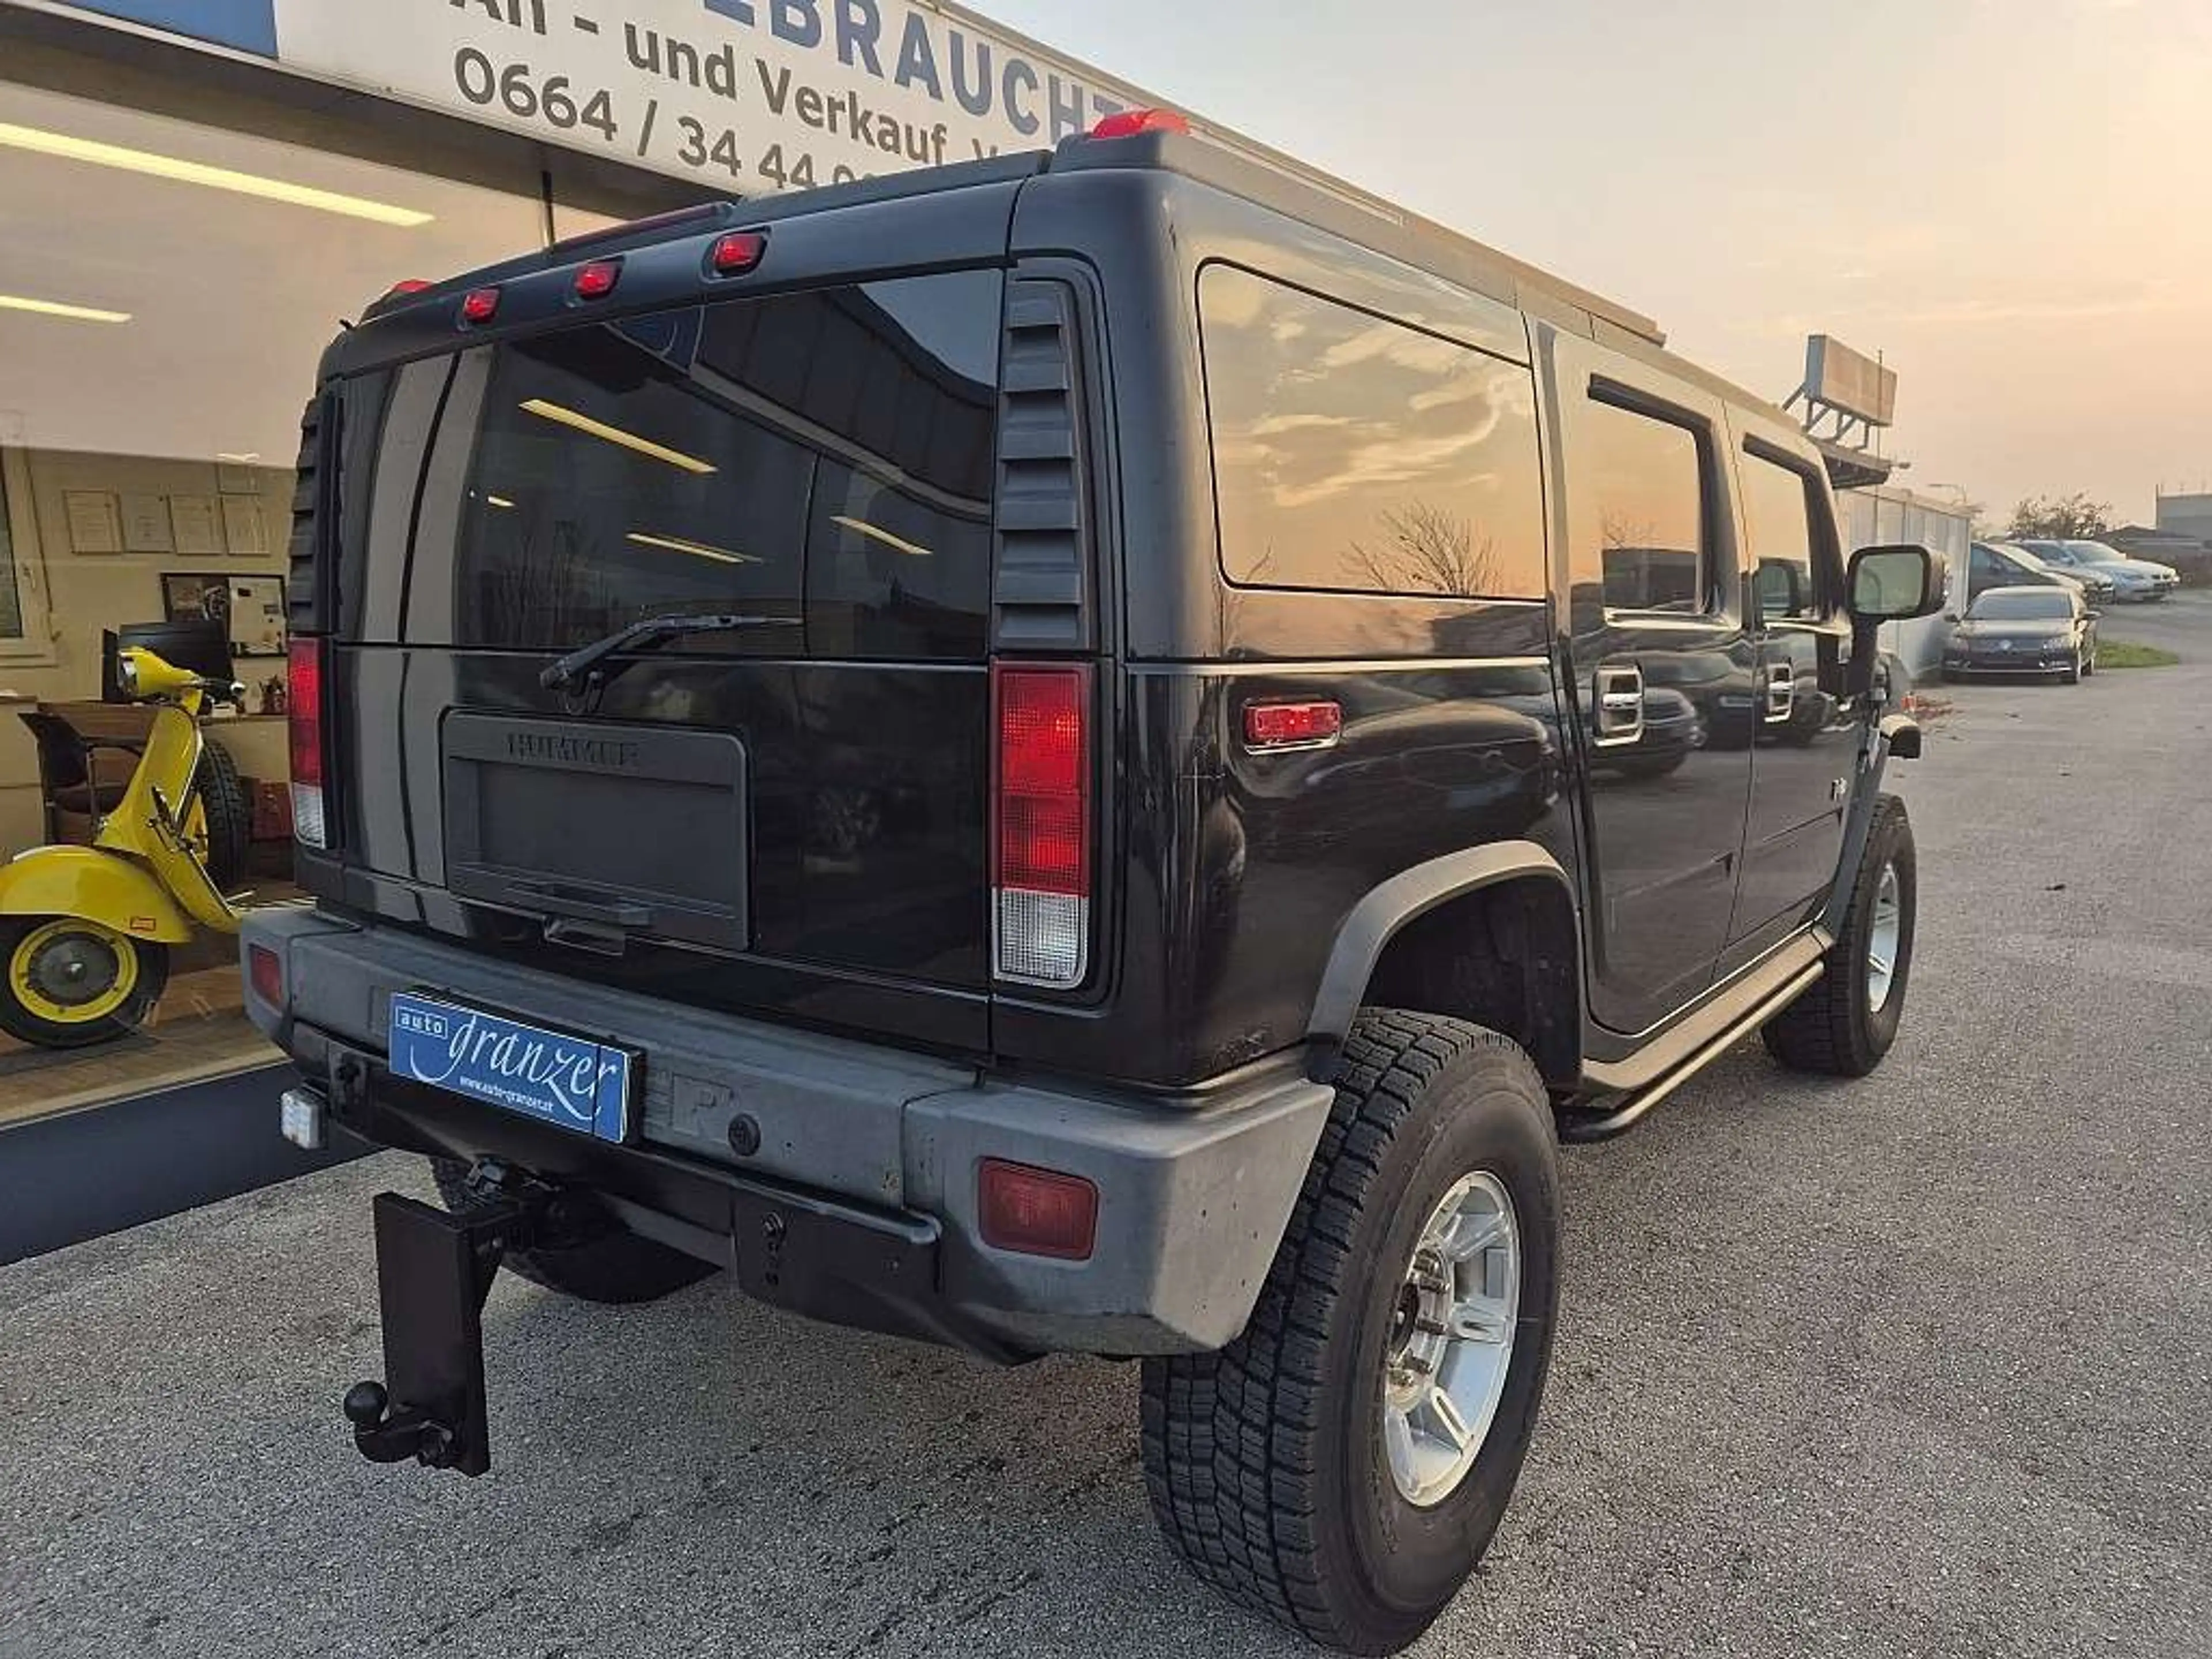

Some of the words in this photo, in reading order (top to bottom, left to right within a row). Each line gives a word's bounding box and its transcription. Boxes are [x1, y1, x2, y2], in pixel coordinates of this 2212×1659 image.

[624, 22, 737, 100] und
[454, 47, 618, 141] 0664
[637, 99, 658, 156] /
[676, 115, 742, 176] 34
[757, 143, 816, 189] 44
[400, 1012, 442, 1035] auto
[410, 1013, 617, 1120] granzer
